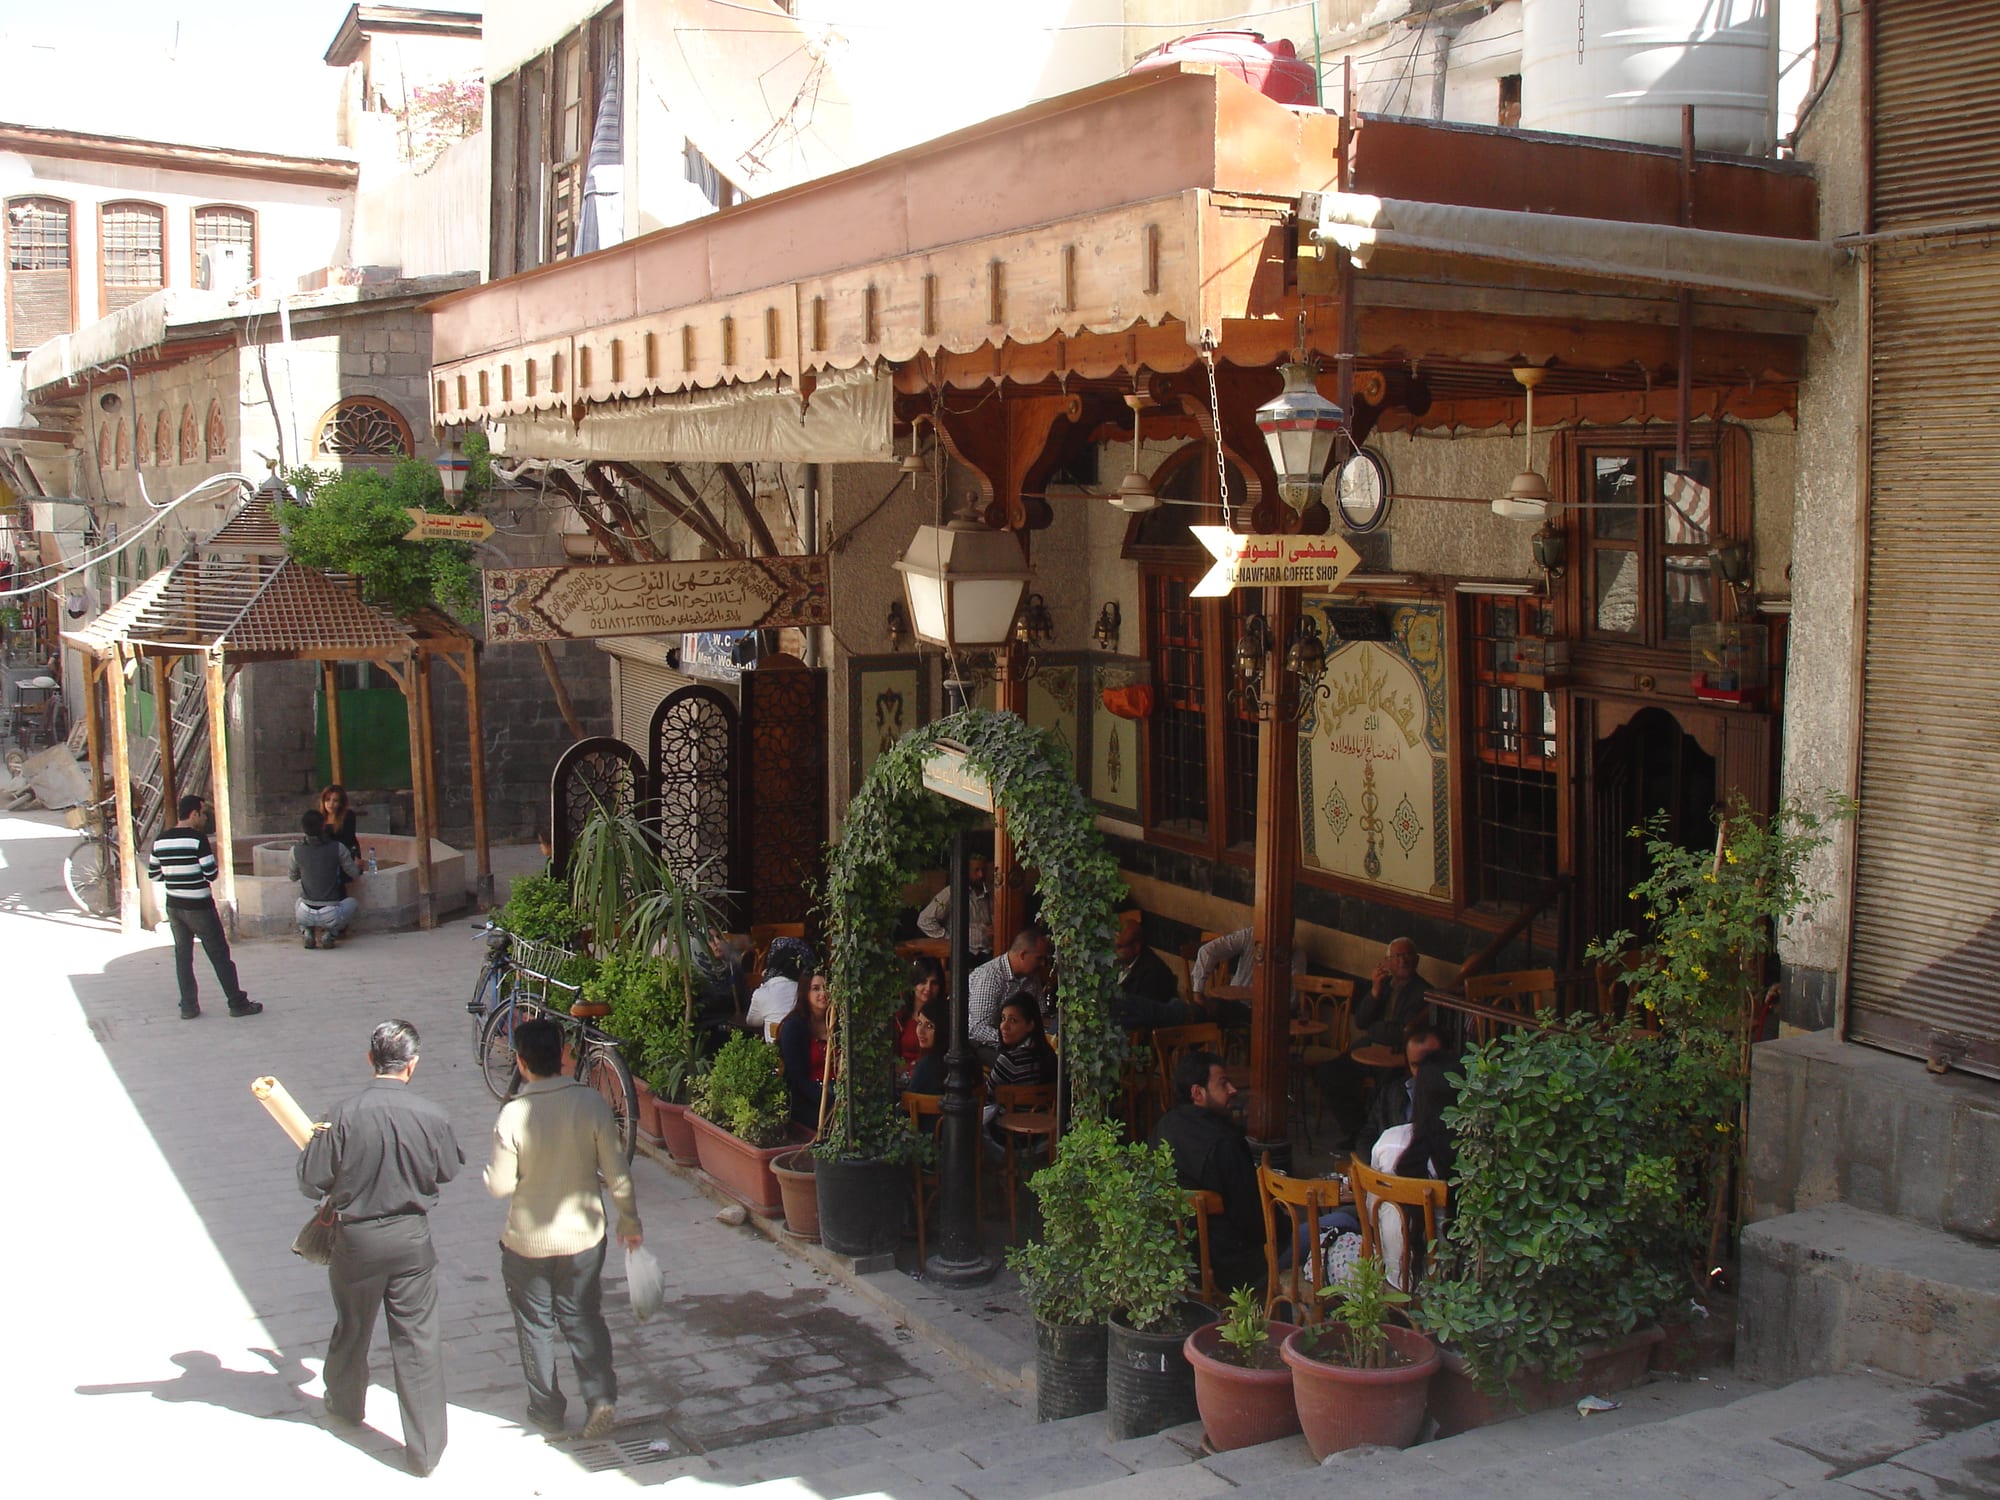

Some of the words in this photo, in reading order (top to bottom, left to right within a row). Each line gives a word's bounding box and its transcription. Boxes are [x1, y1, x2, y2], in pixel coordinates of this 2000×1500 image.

[1289, 540, 1338, 563] مقهى
[1226, 566, 1281, 583] AL-NAWFARA
[1283, 565, 1314, 582] COFFEE
[1315, 565, 1338, 581] SHOP
[698, 651, 712, 665] Men
